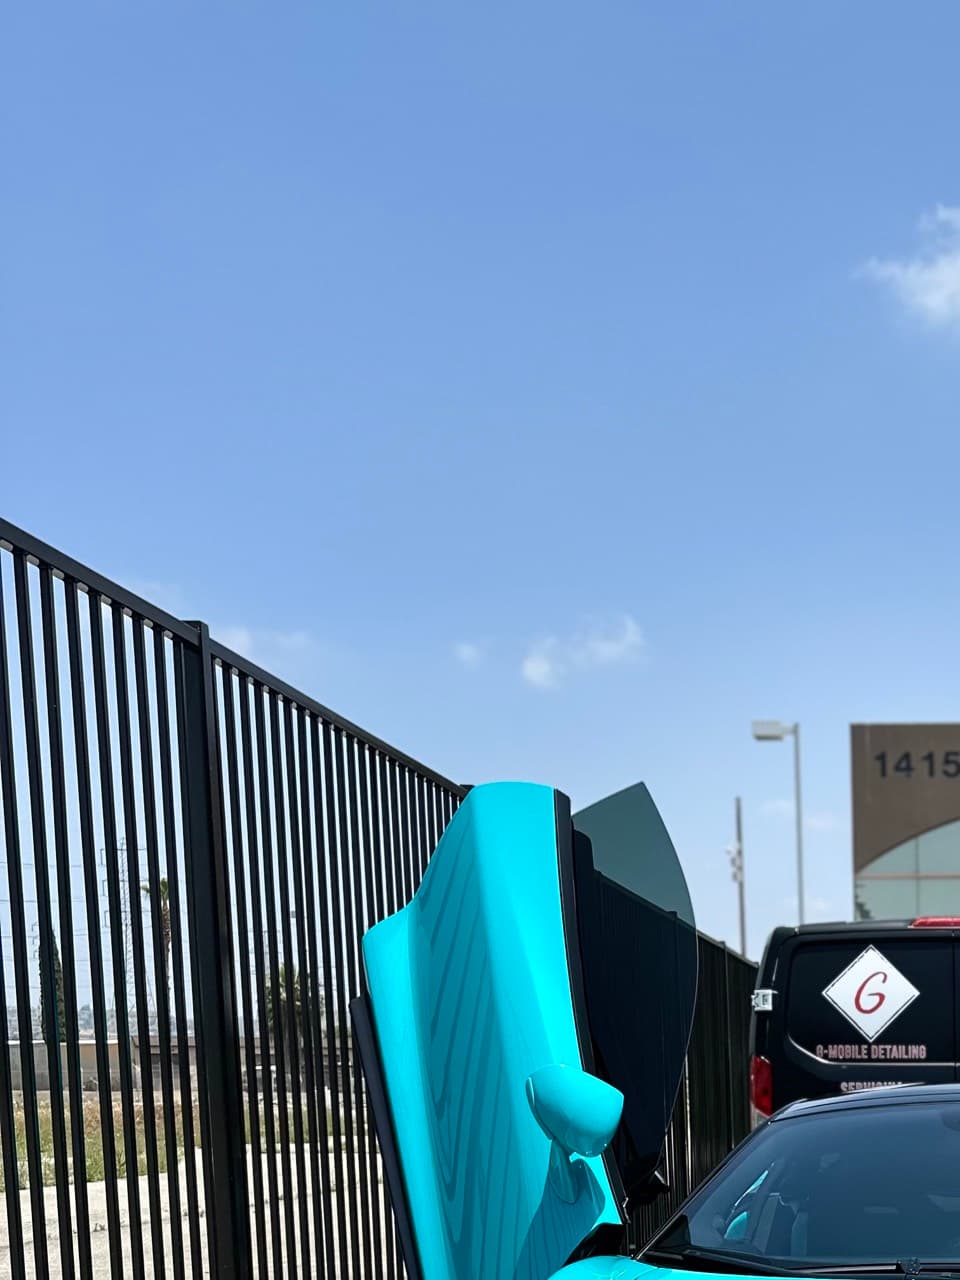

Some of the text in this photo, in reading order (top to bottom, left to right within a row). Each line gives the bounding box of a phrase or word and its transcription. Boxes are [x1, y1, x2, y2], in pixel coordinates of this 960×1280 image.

[854, 971, 888, 1015] G
[816, 1044, 927, 1060] G-MOBILE DETAILING
